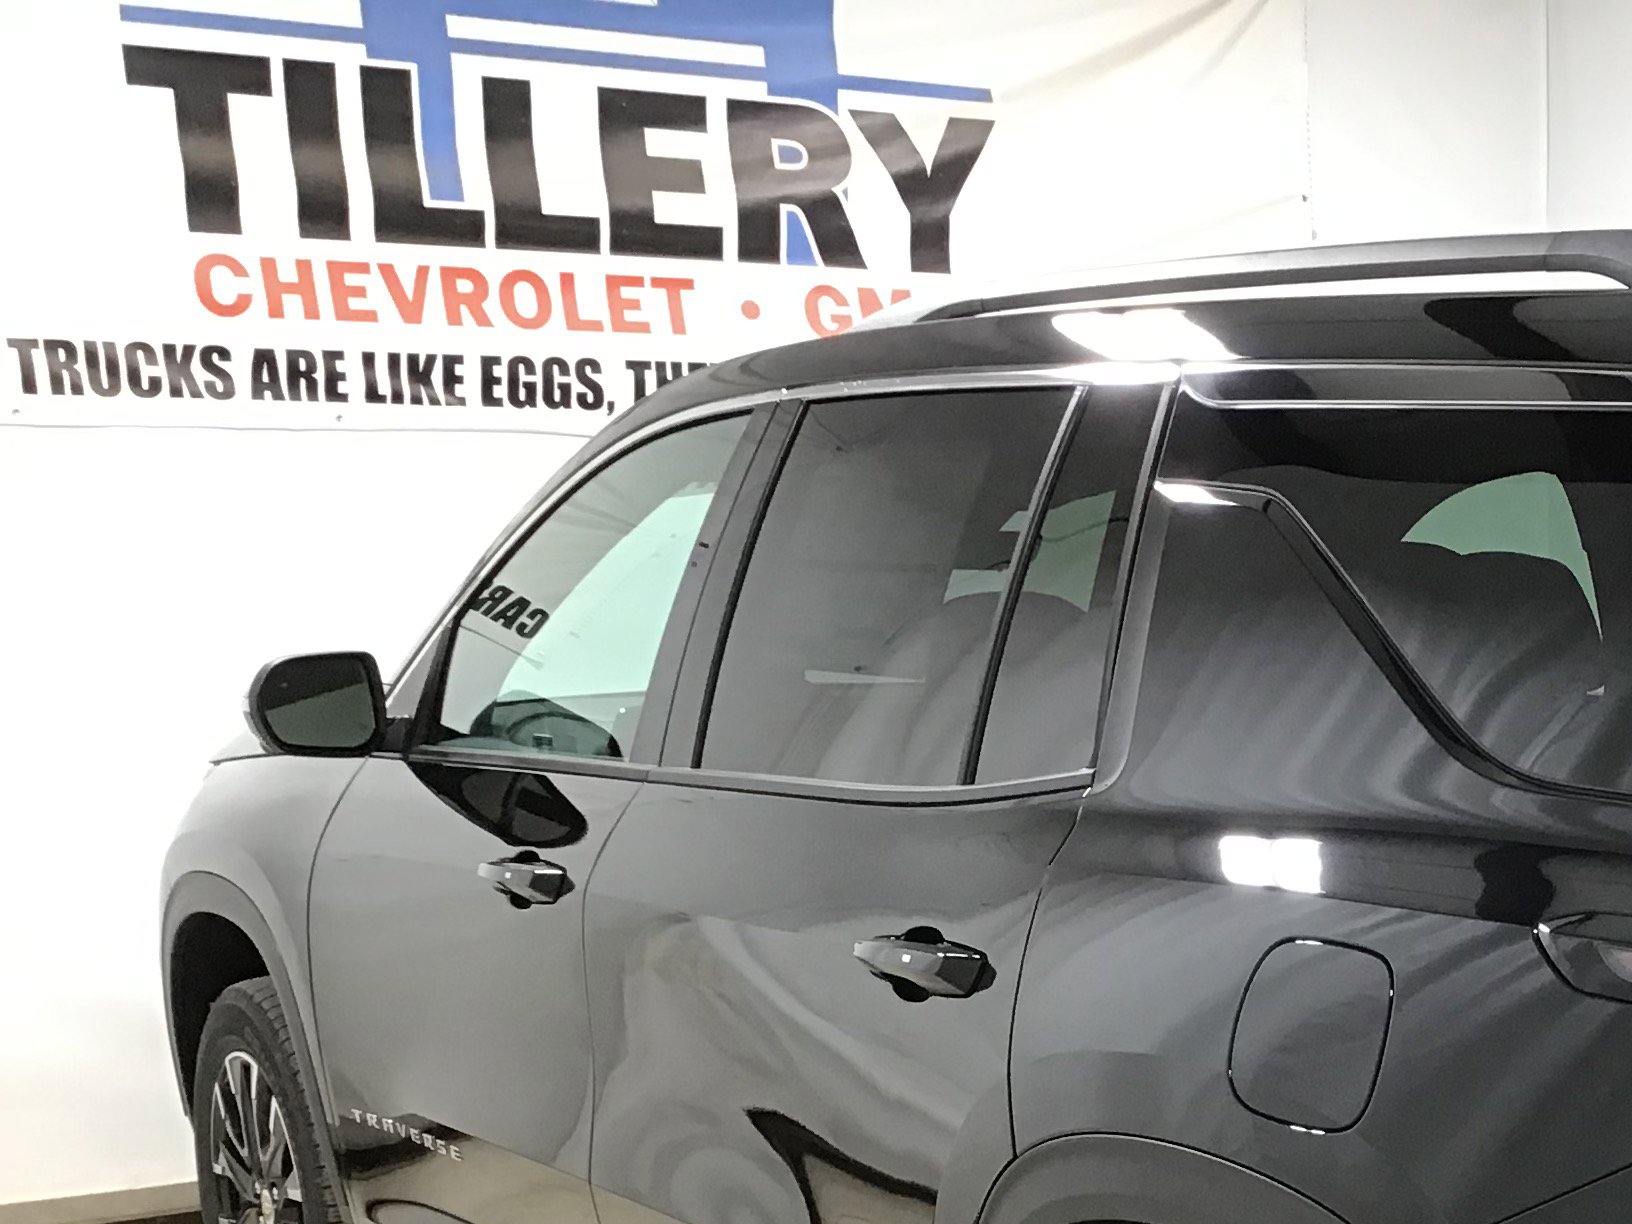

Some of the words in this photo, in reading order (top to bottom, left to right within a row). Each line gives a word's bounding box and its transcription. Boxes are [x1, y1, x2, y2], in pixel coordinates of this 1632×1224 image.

[121, 44, 996, 274] TILLERY
[193, 252, 696, 336] CHEVROLET
[6, 337, 236, 403] TRUCKS
[250, 347, 348, 405] ARE
[361, 350, 466, 408] LIKE
[480, 354, 615, 416] EGGS,
[350, 1108, 464, 1162] TRAVERSE
